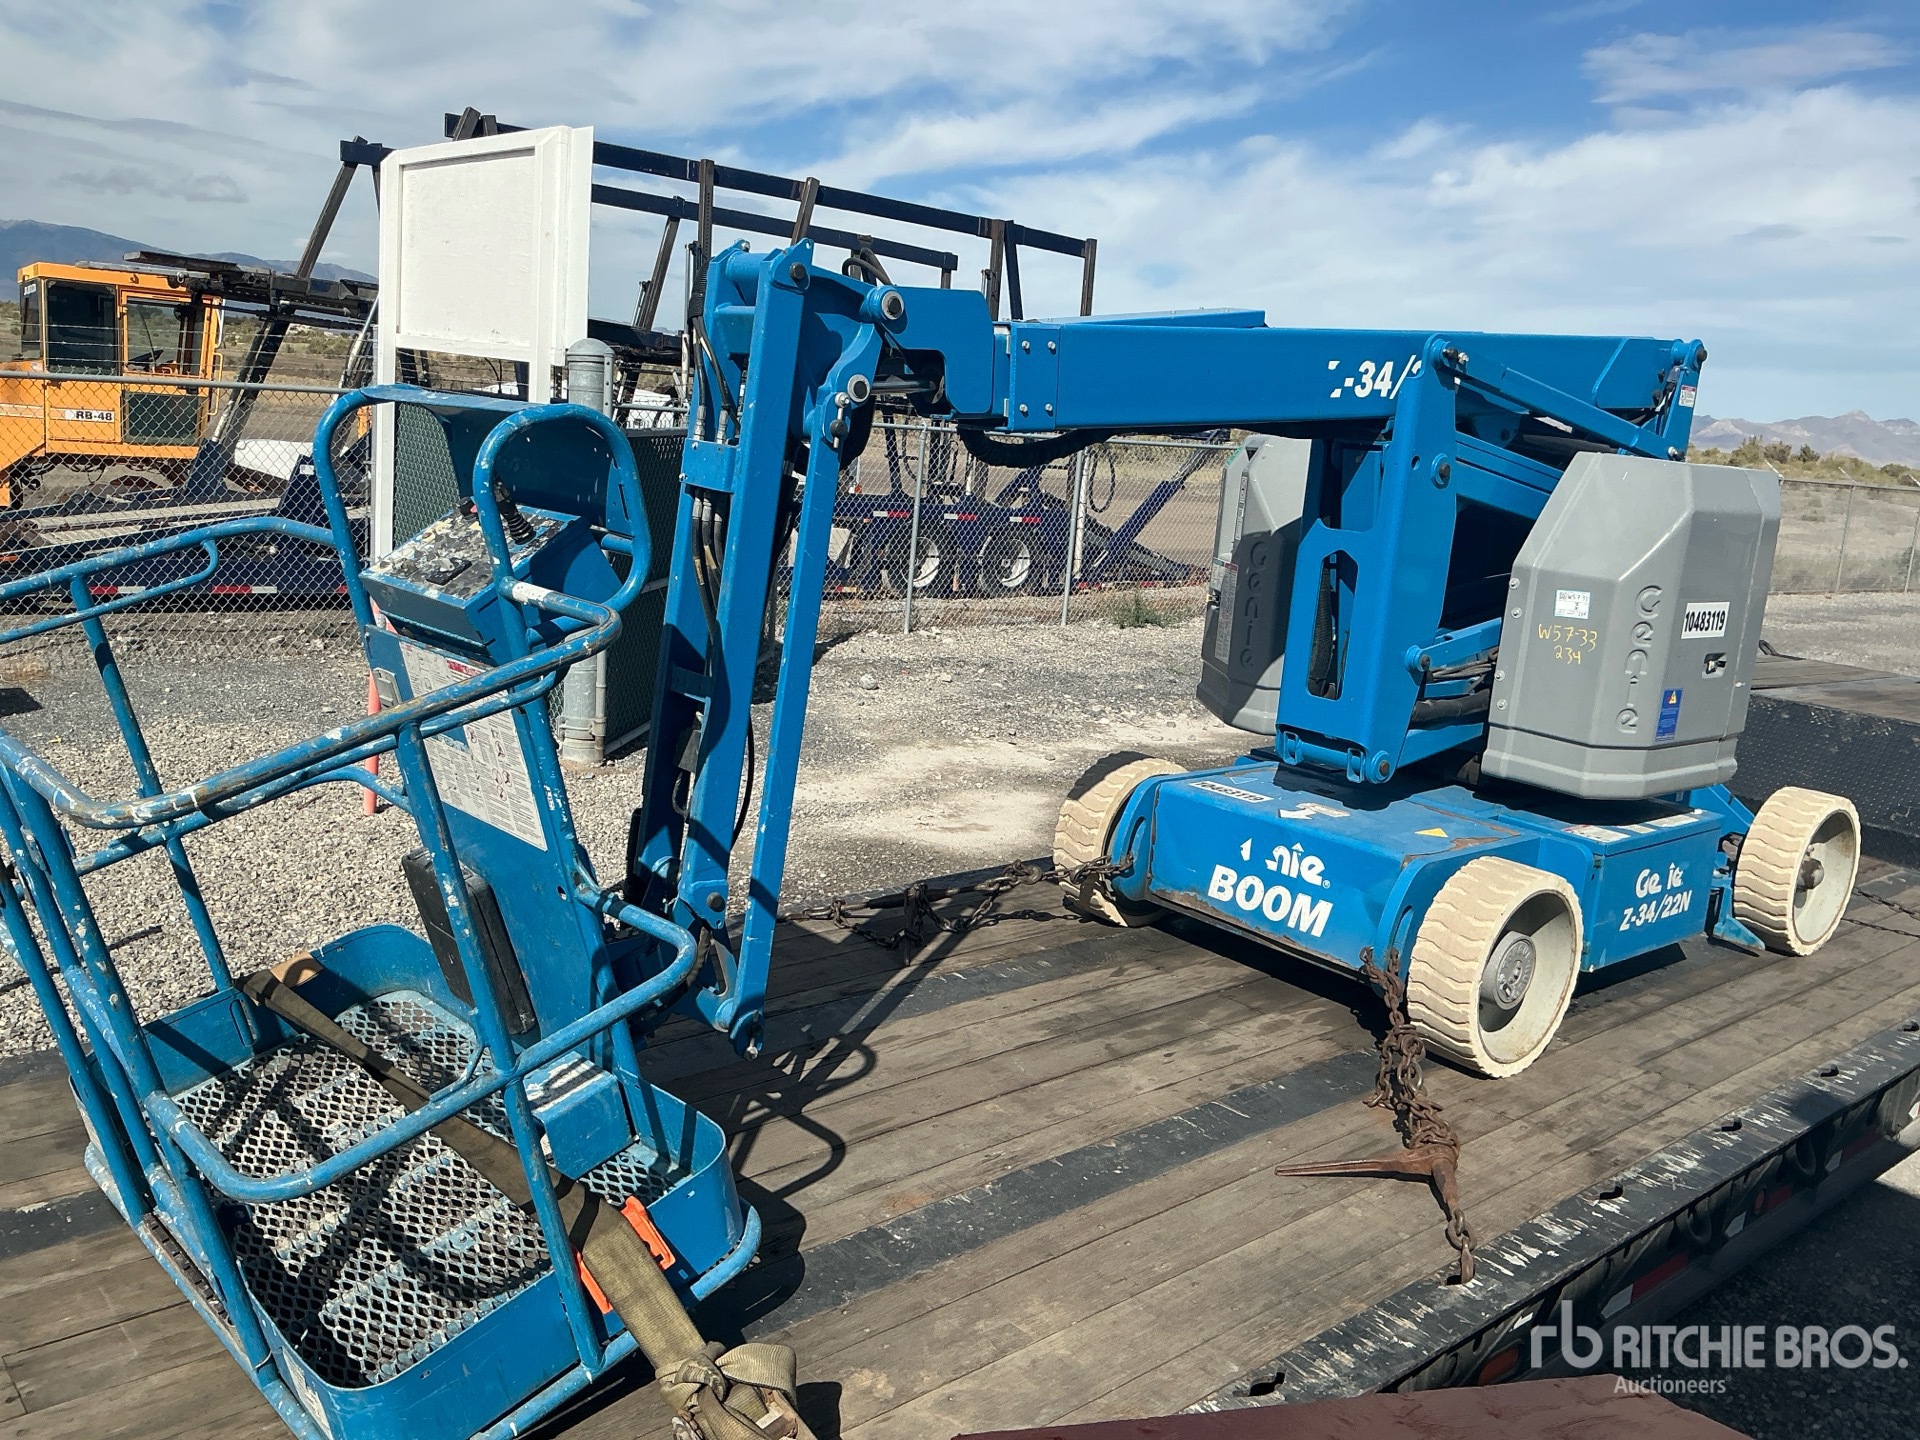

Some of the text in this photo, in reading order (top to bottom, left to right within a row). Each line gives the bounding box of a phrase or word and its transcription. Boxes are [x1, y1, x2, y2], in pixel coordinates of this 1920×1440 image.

[75, 411, 113, 421] RB-48
[1684, 610, 1726, 632] 10483119
[1553, 644, 1581, 665] 234
[1615, 584, 1662, 735] Genie
[1635, 862, 1684, 899] Geie
[1208, 864, 1333, 938] BOOM
[1619, 890, 1693, 932] Z-34/22N
